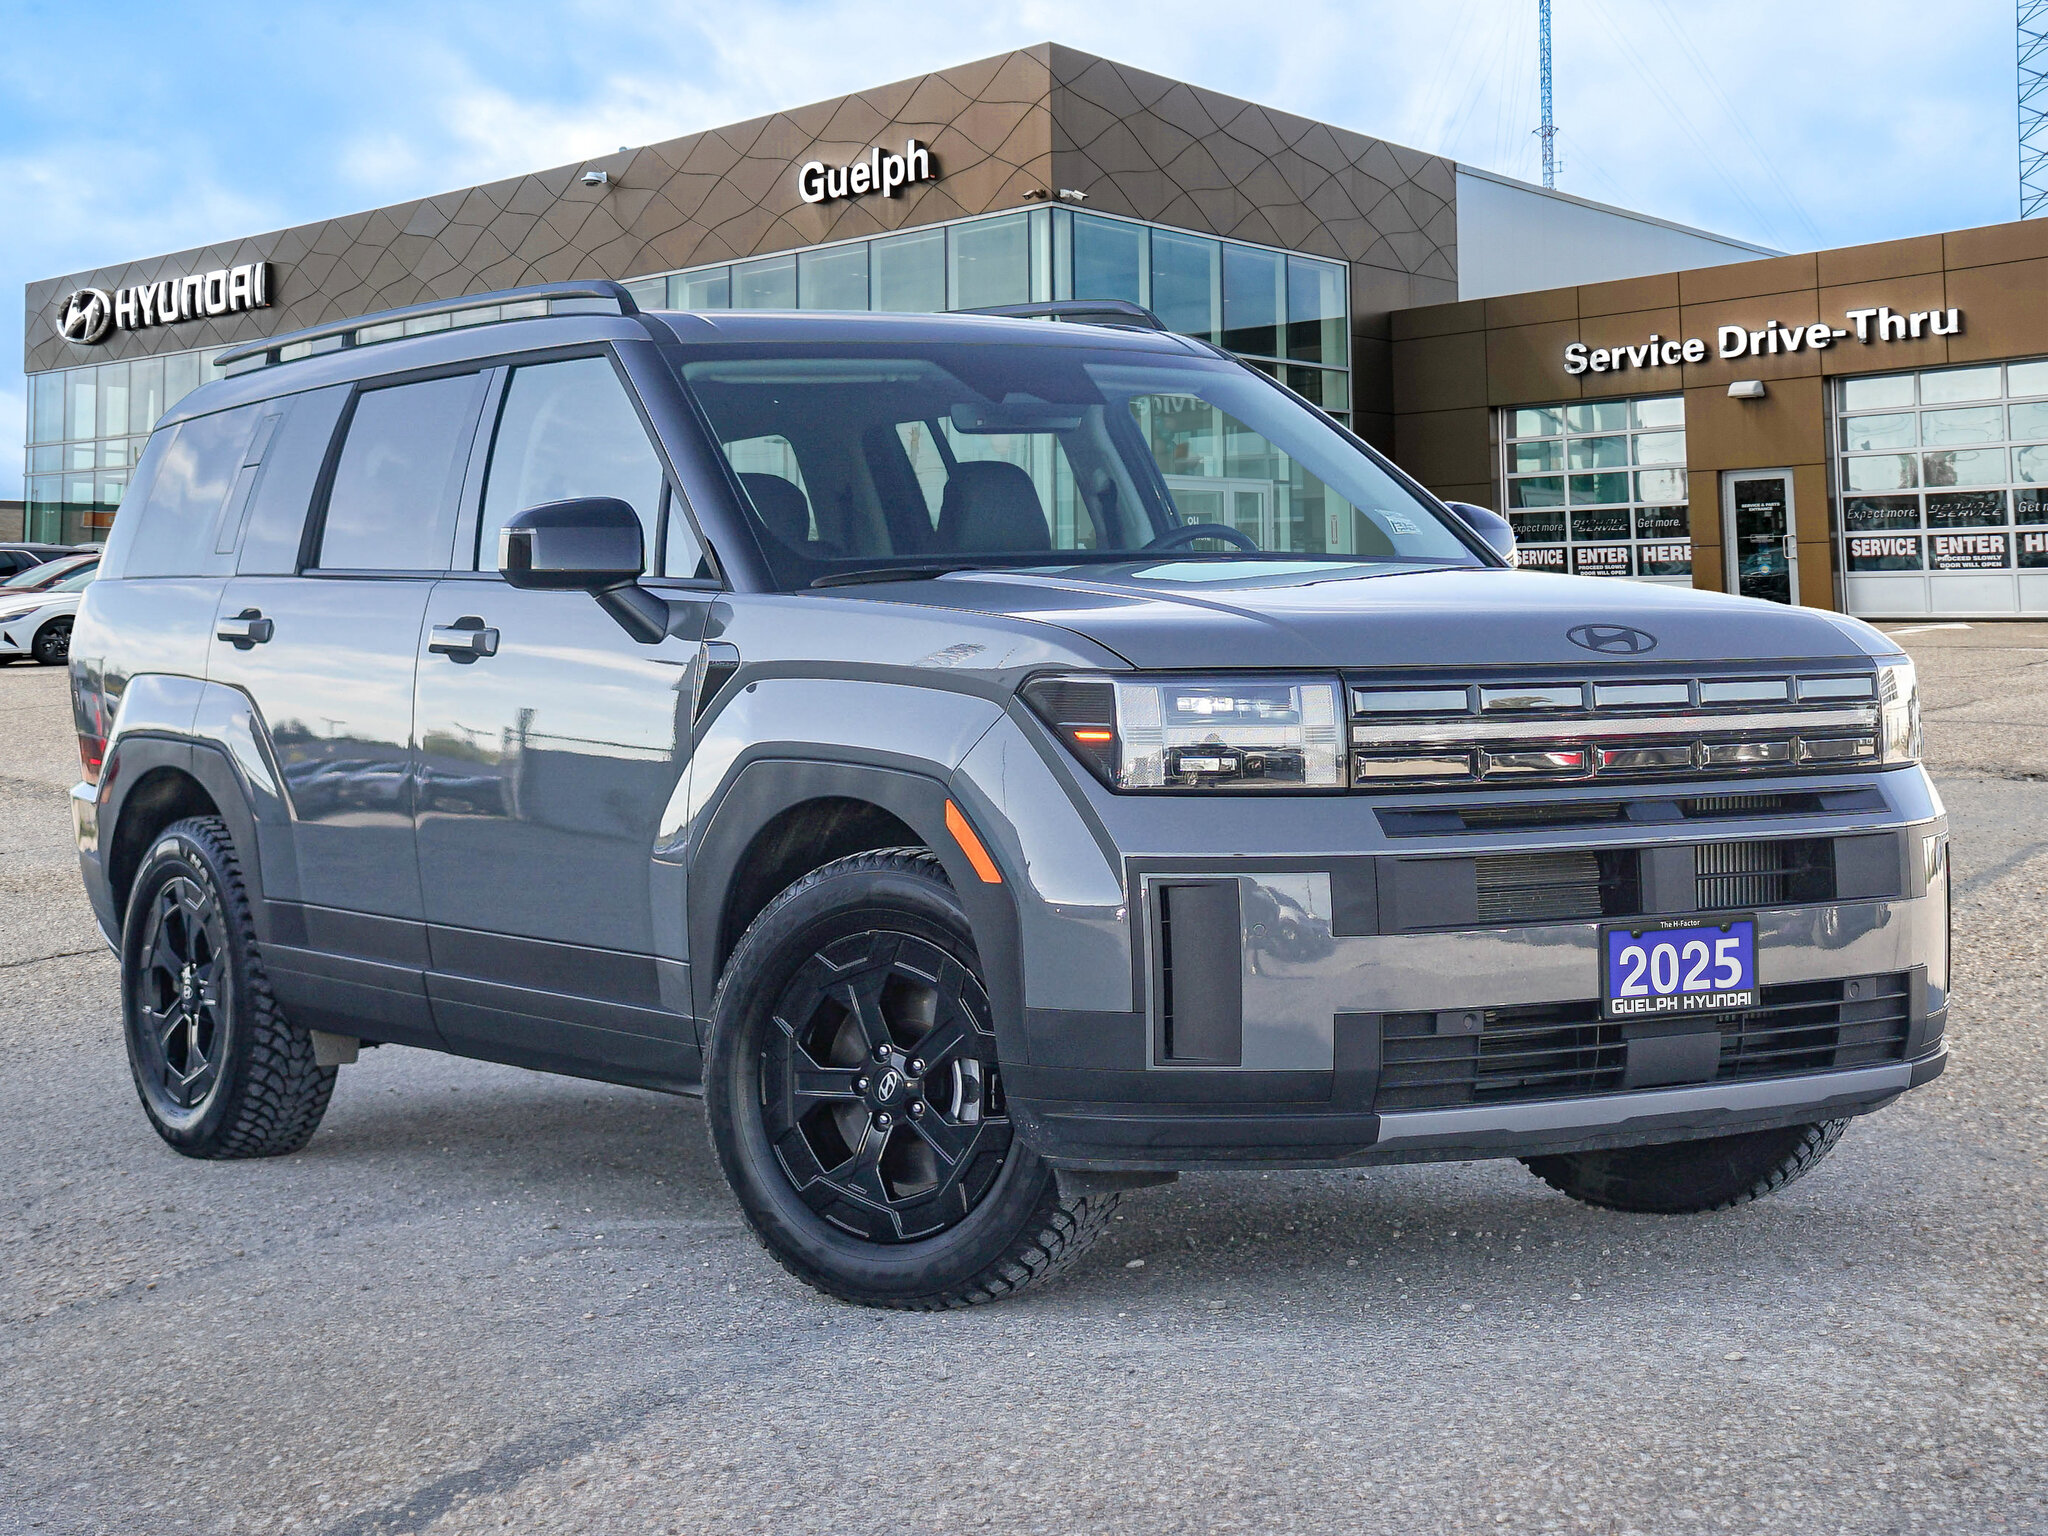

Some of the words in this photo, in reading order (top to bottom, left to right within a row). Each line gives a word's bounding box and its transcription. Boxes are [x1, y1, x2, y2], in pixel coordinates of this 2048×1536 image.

[799, 138, 929, 203] Guelph
[115, 262, 268, 330] HYUNDAI
[1563, 334, 1705, 375] Service
[1717, 306, 1961, 358] Drive-Thru
[1847, 508, 1885, 520] Expect
[1887, 508, 1918, 518] more.
[1936, 508, 2003, 518] SERVICE
[2018, 501, 2040, 512] Get
[1512, 523, 1540, 534] Expect
[1541, 523, 1565, 532] more.
[1637, 518, 1653, 528] Get
[1655, 518, 1681, 527] more.
[1517, 549, 1564, 566] SERVICE
[1577, 547, 1628, 564] ENTER
[1642, 545, 1692, 562] HERE
[1851, 538, 1917, 557] SERVICE
[1935, 535, 2005, 554] ENTER
[2024, 533, 2048, 552] H
[1660, 921, 1673, 929] The
[1673, 919, 1700, 928] H-Factor
[1619, 937, 1743, 997] 2025
[1611, 996, 1678, 1014] GUELPH
[1683, 991, 1752, 1010] HYUNDAI
